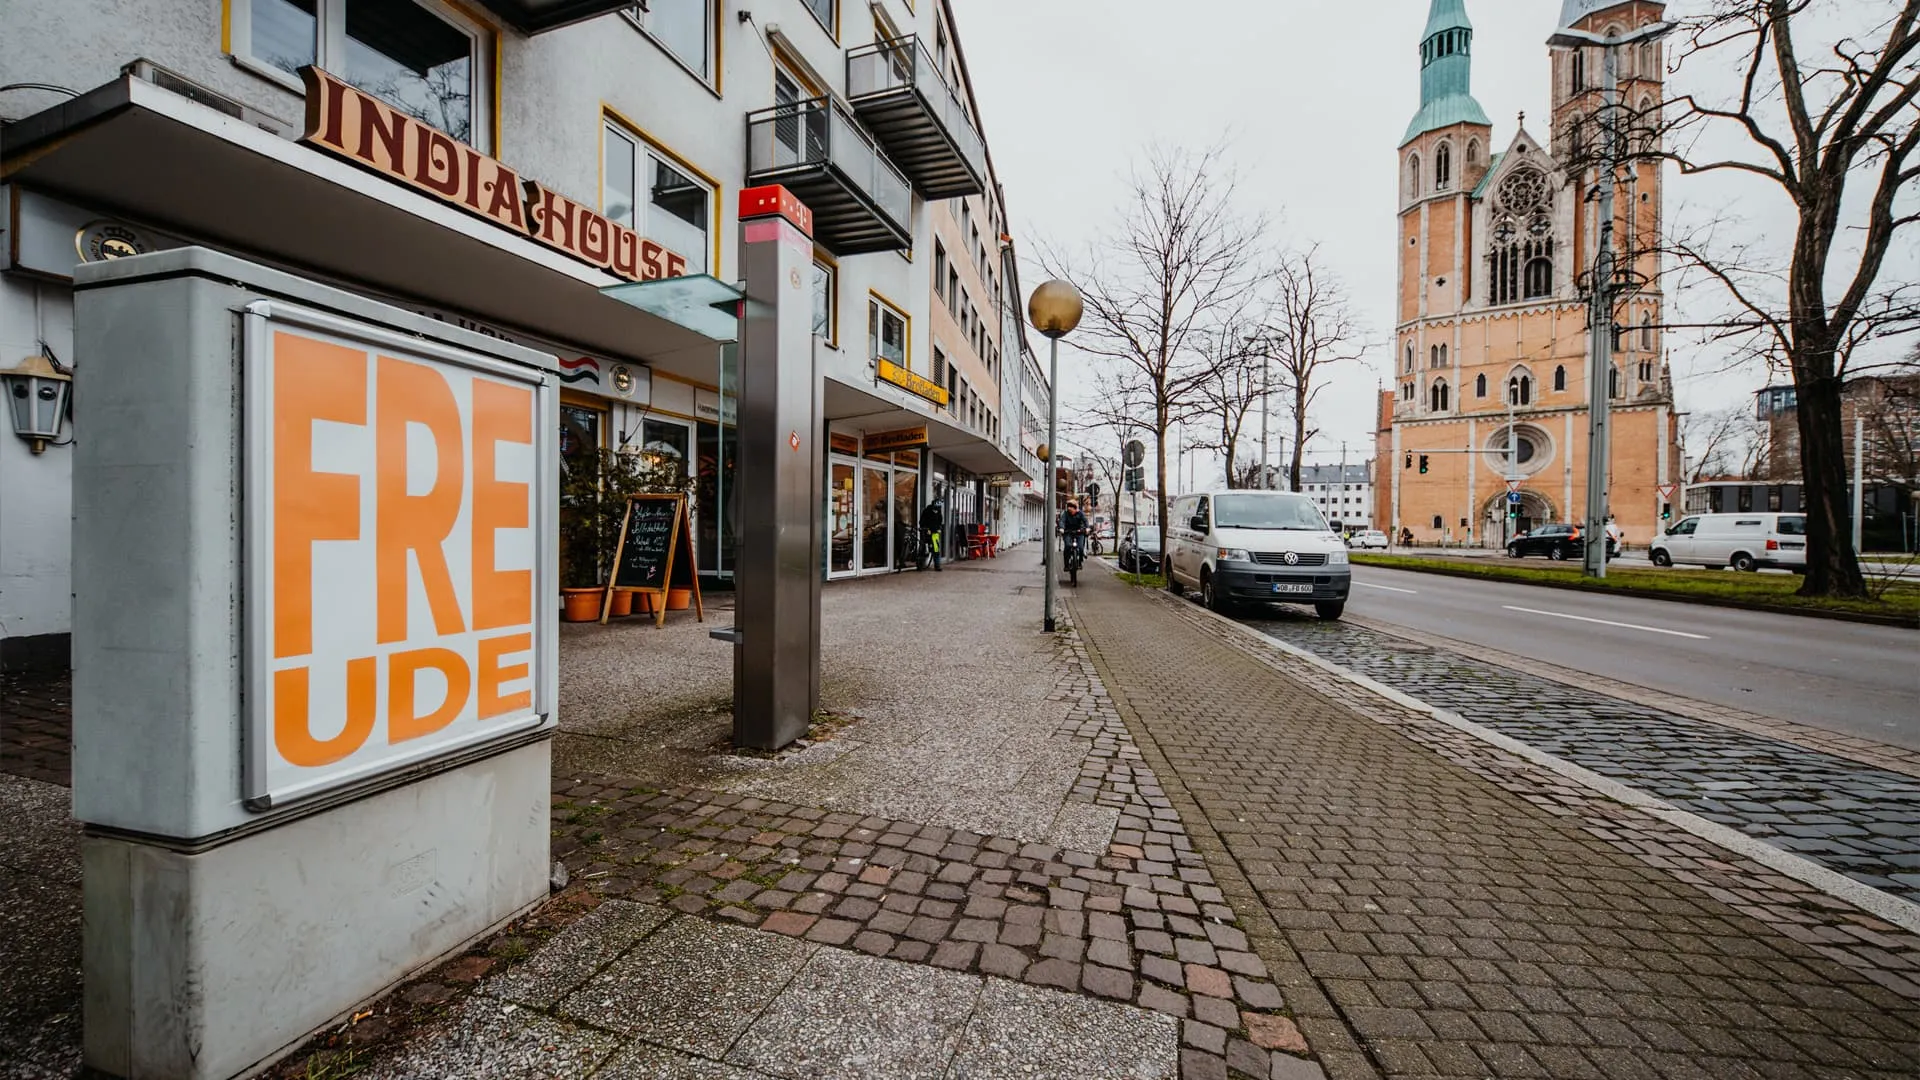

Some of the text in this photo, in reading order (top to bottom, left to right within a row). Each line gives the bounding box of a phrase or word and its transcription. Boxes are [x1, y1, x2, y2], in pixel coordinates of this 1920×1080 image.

[323, 74, 686, 282] INDIA HOUSE
[797, 201, 807, 229] T
[274, 330, 533, 659] FRE
[274, 632, 533, 768] UDE
